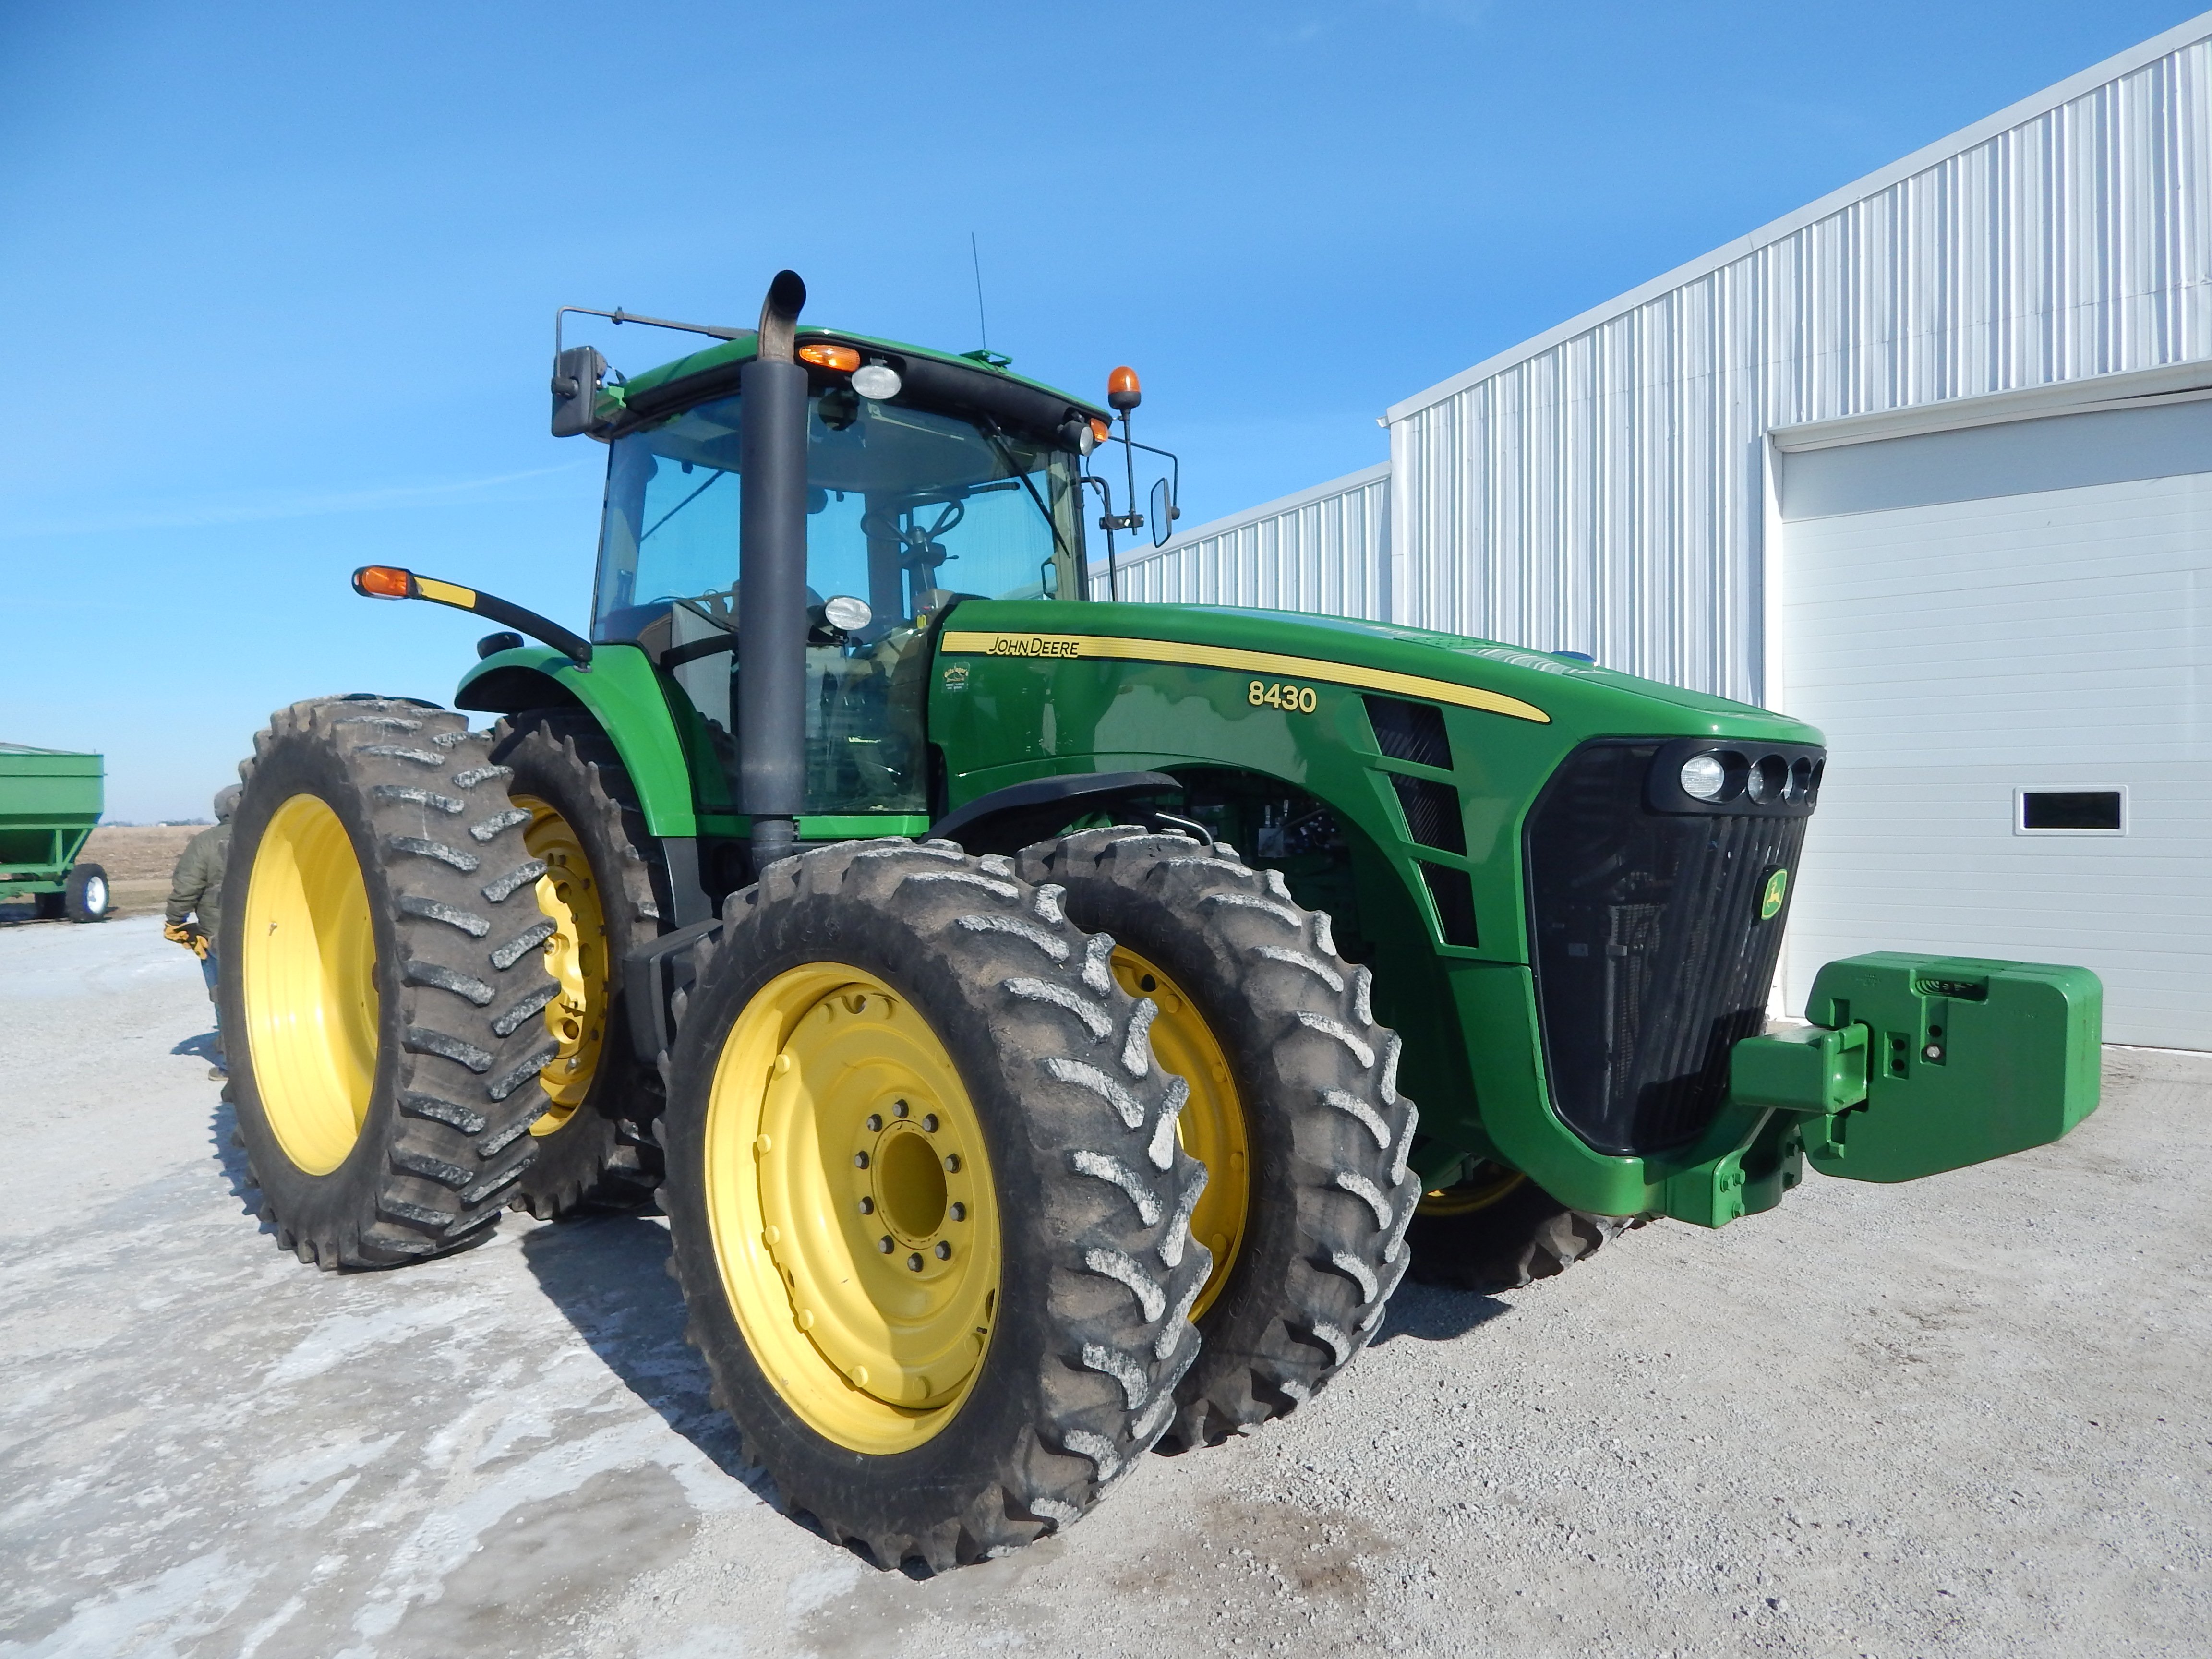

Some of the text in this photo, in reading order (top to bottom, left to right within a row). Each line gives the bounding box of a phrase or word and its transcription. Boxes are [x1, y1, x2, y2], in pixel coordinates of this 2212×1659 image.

[988, 636, 1080, 655] JOHN DEERE
[1248, 680, 1317, 713] 8430
